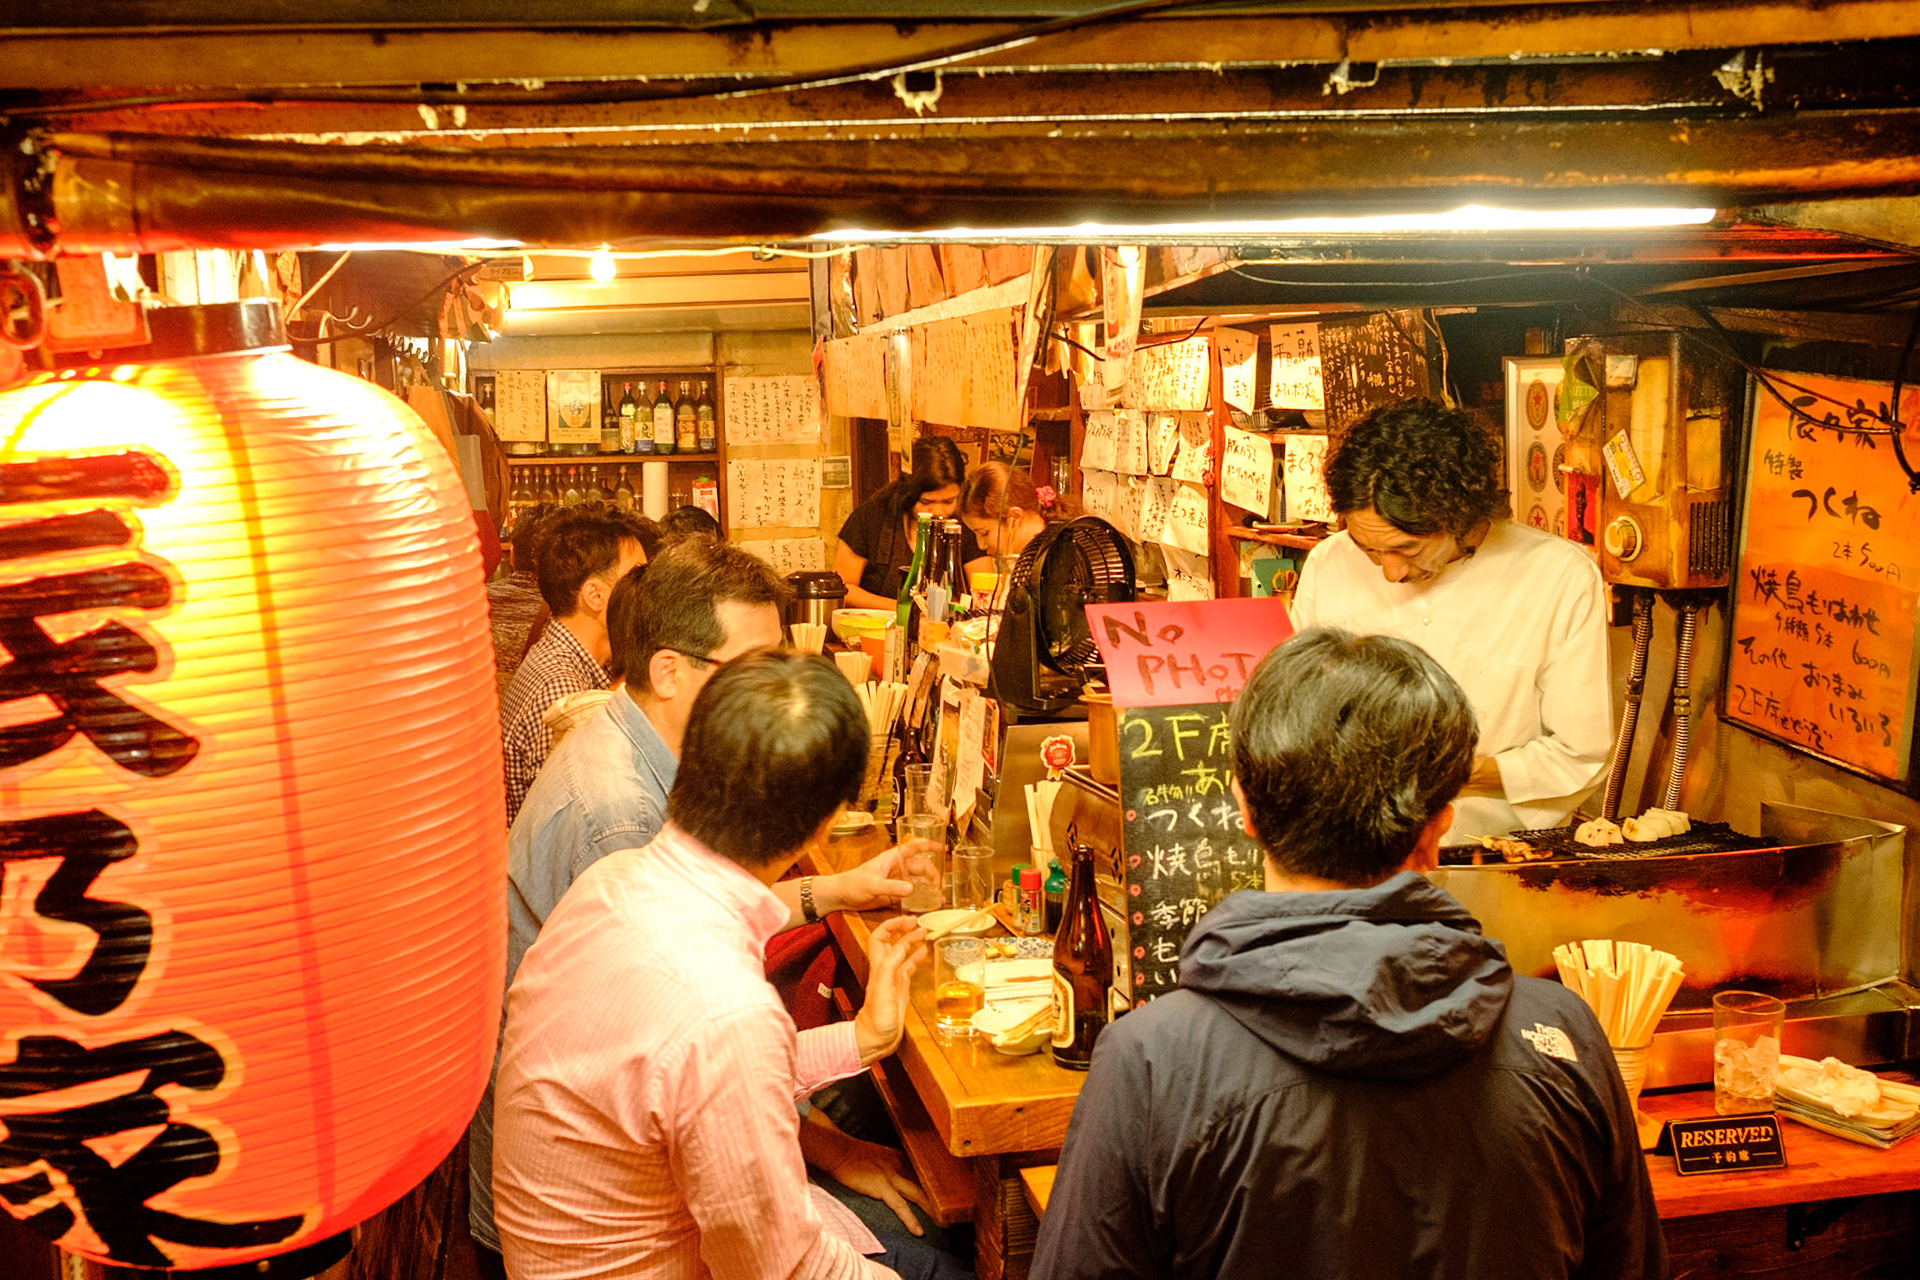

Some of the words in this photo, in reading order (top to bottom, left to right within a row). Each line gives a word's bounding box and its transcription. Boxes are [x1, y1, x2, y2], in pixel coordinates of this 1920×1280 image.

[1763, 448, 1804, 480] 特製
[1791, 486, 1882, 531] つくね
[1833, 540, 1853, 560] 2本
[1860, 541, 1901, 582] 500円
[1750, 565, 1881, 636] 焼鳥もりあわせ
[1102, 611, 1184, 649] No
[1737, 636, 1793, 669] その他
[1852, 639, 1890, 679] 600円
[1801, 661, 1866, 701] おつまみ
[1829, 703, 1892, 747] いろいろ
[1145, 800, 1245, 832] つくね
[1680, 1125, 1774, 1148] RESERVED
[1711, 1150, 1750, 1165] 予約席
